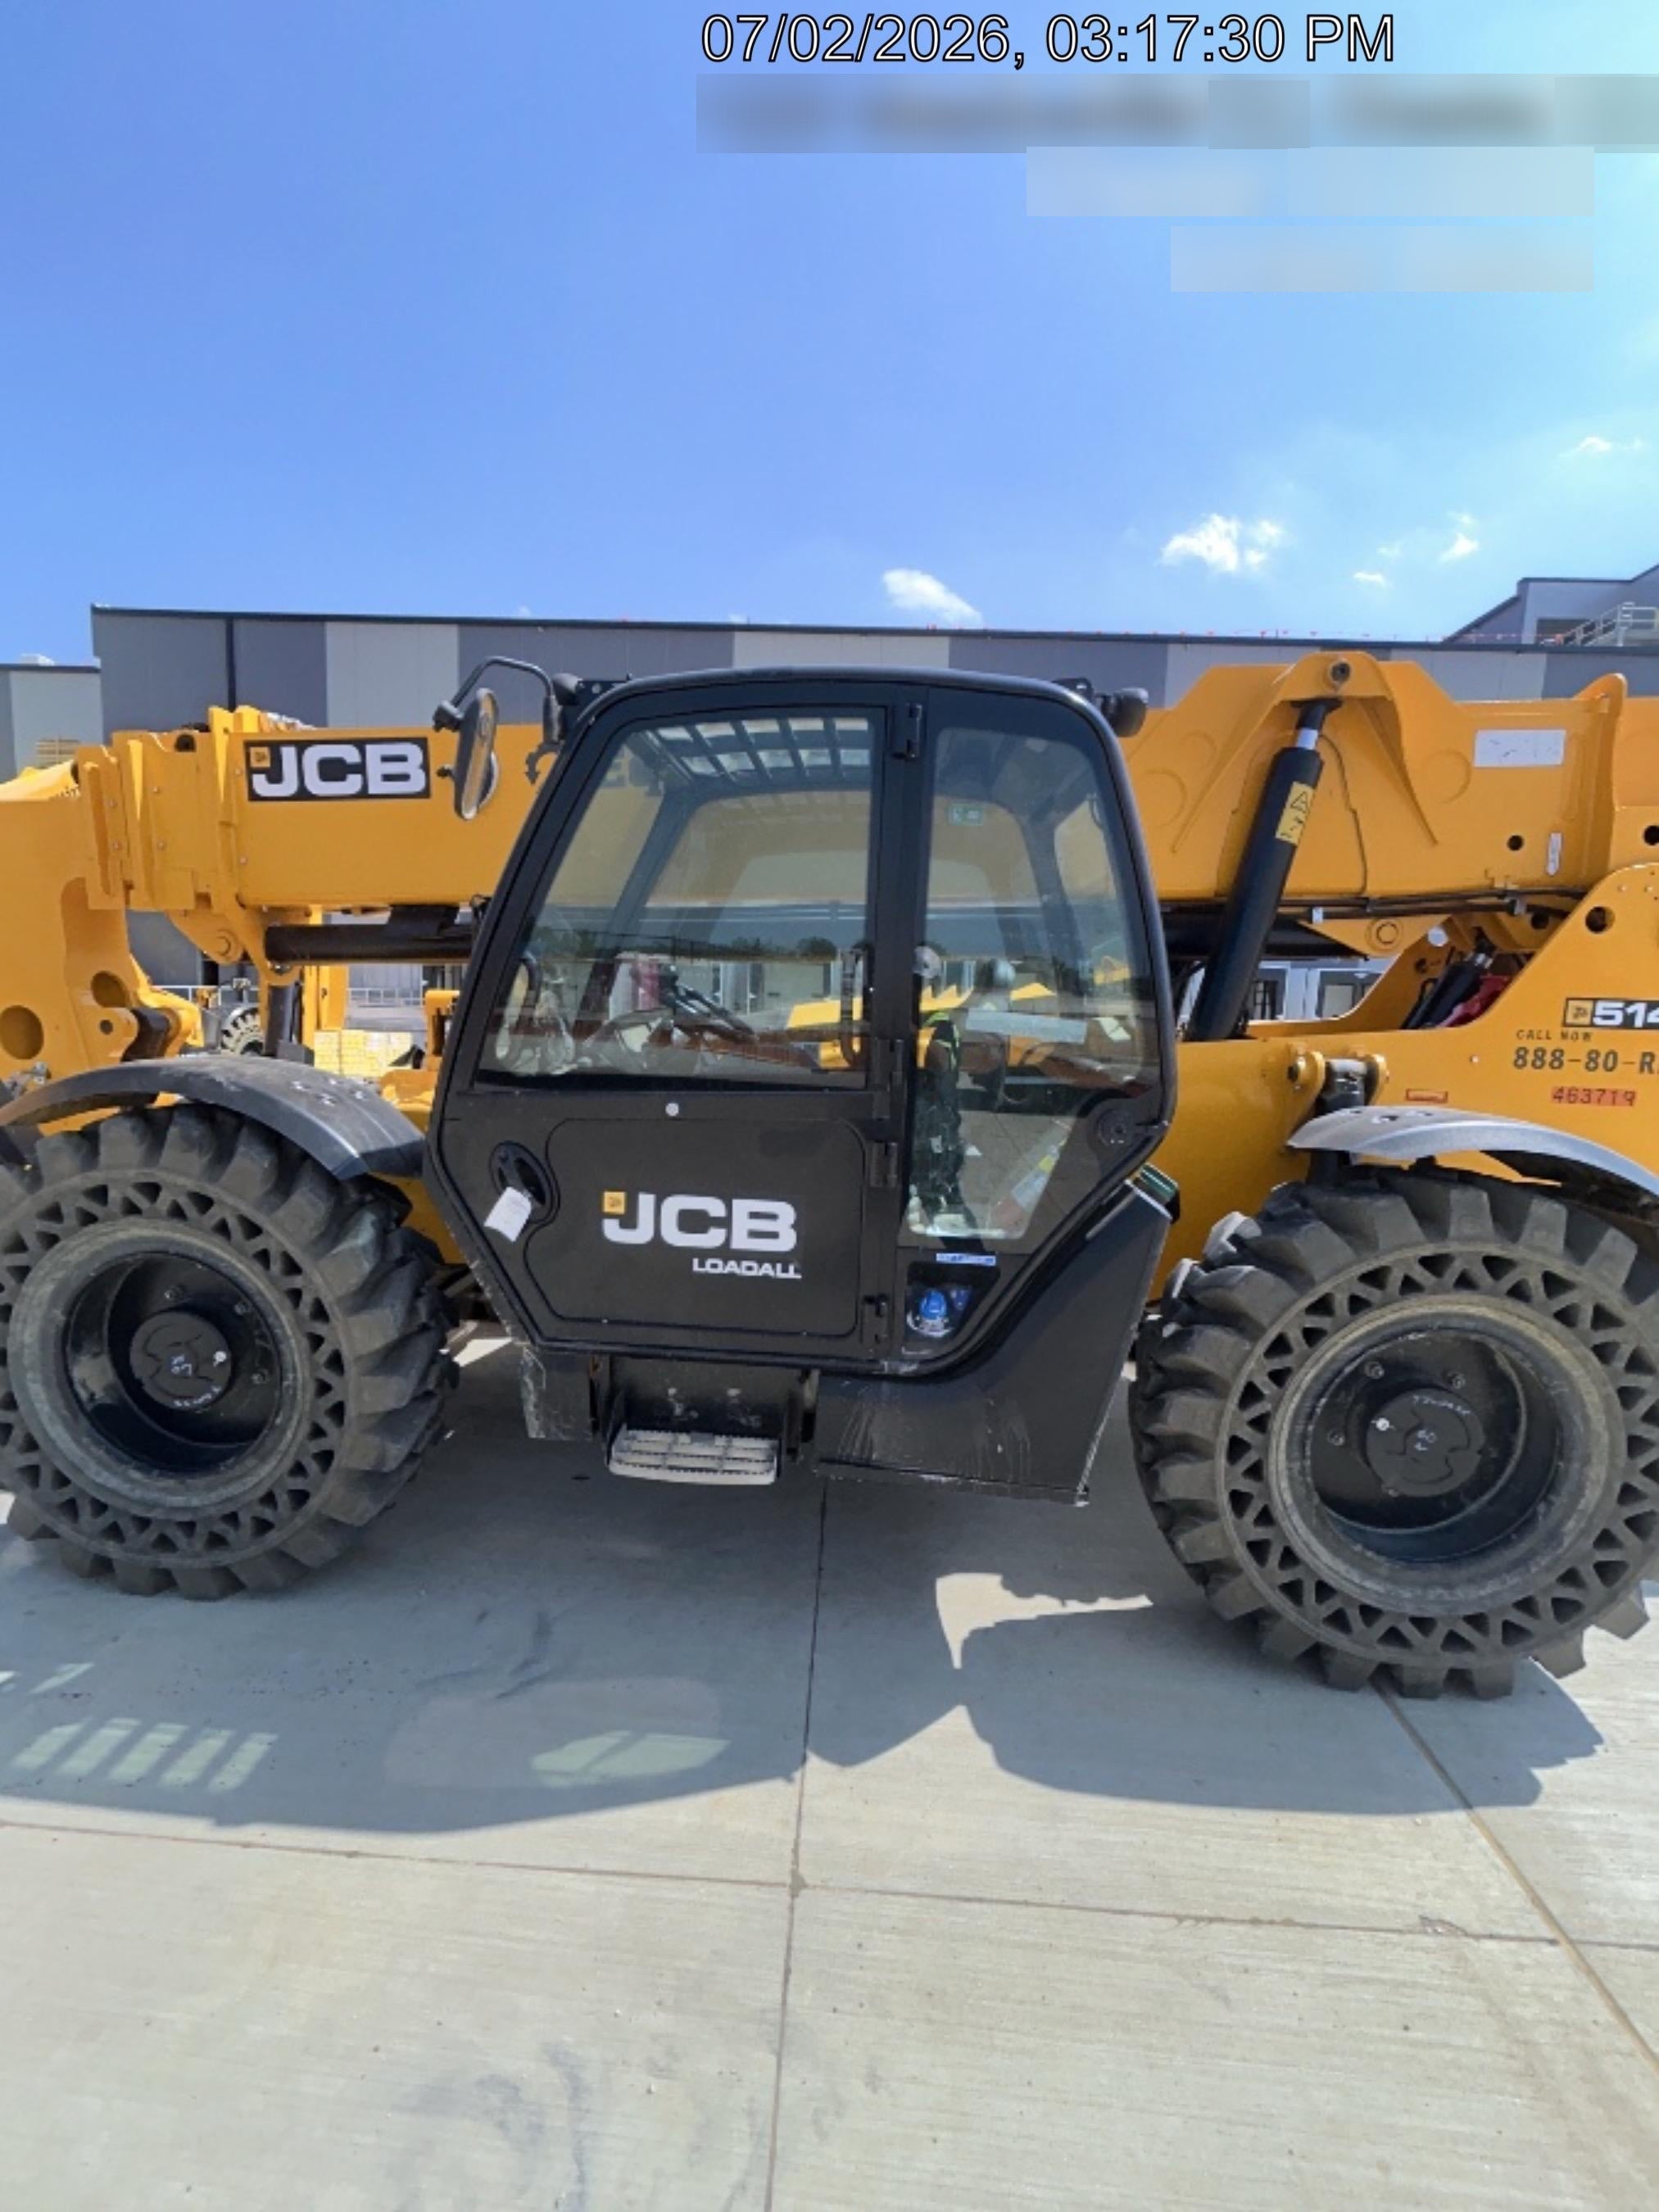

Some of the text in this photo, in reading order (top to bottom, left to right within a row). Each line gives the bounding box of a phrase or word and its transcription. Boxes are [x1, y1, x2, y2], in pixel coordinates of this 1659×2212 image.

[252, 741, 426, 797] JCB
[1516, 1029, 1593, 1042] CALL NOW
[1513, 1046, 1659, 1075] 888-80-R
[1552, 1086, 1636, 1107] 463719
[602, 1192, 797, 1252] JCB
[692, 1258, 802, 1280] LOADALL
